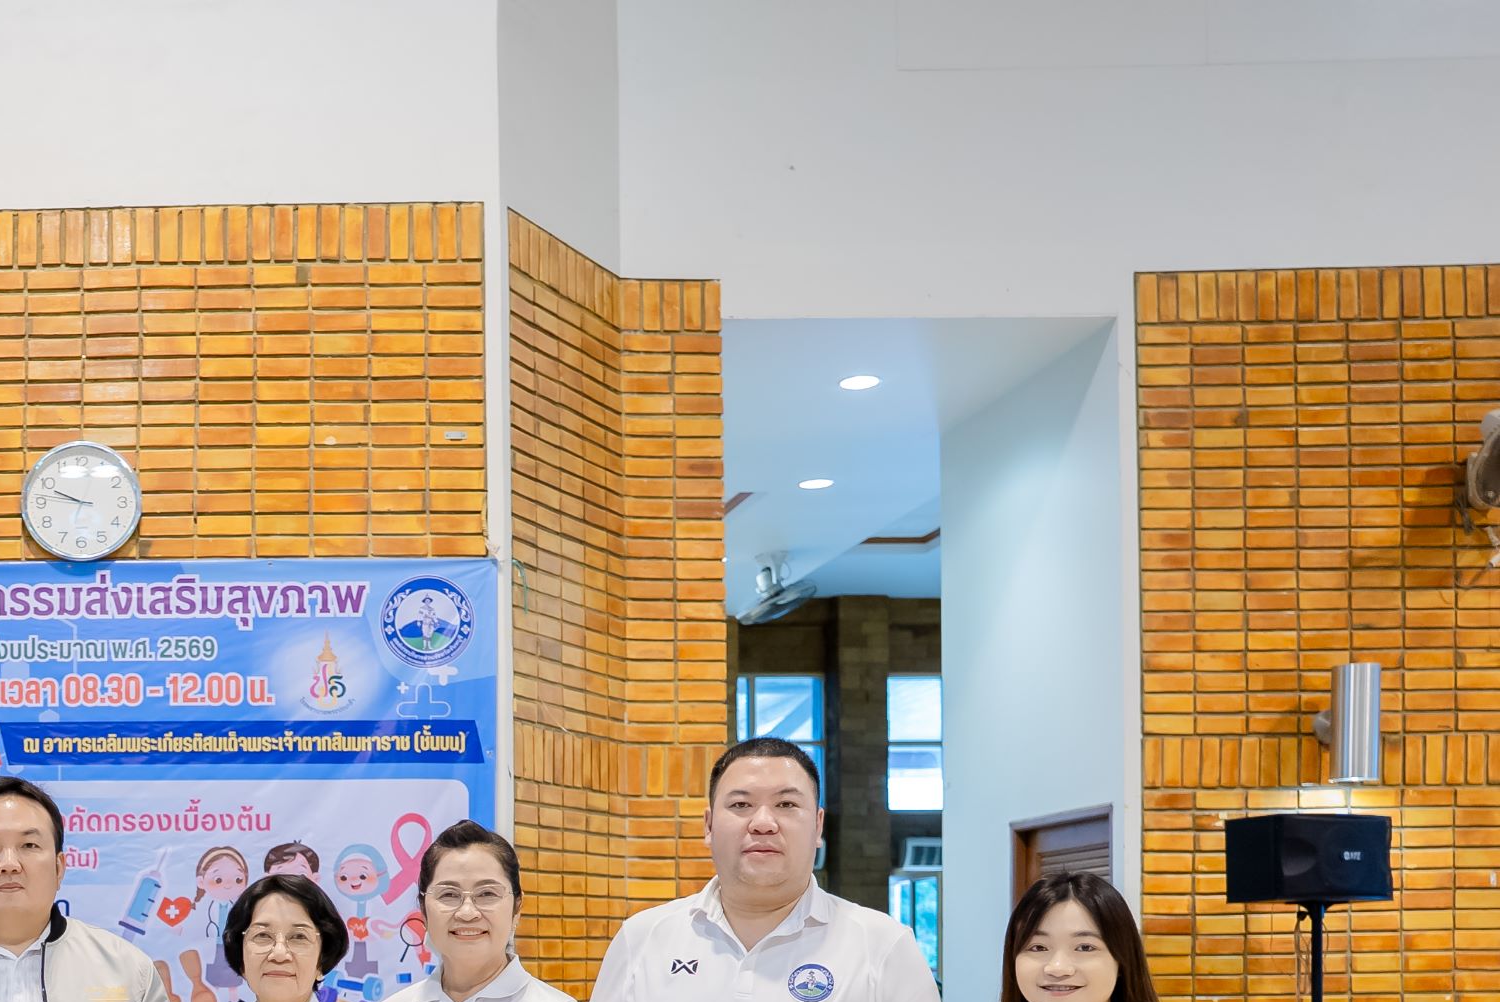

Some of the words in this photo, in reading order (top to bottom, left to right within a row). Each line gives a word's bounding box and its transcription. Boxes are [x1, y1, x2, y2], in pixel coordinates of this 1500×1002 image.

[74, 456, 89, 467] 12
[40, 476, 56, 490] 10
[110, 475, 122, 489] 2
[35, 496, 47, 510] 9
[116, 495, 128, 509] 3
[41, 515, 53, 529] 8
[110, 515, 121, 528] 4
[58, 531, 69, 544] 7
[75, 536, 88, 549] 6
[96, 530, 108, 544] 5
[112, 638, 153, 659] พ.ศ.
[159, 638, 215, 659] 2569
[64, 675, 142, 705] 08.30
[166, 675, 242, 704] 12.00
[251, 677, 274, 703] น.
[23, 738, 40, 754] ณ
[43, 731, 410, 754] อาคารเฉลิมพระเกียรติสมเด็จพระเจ้าตากสินมหาราช
[414, 725, 466, 754] (ชั้นบน)
[62, 799, 272, 832] คัดกรองเบื้องต้น
